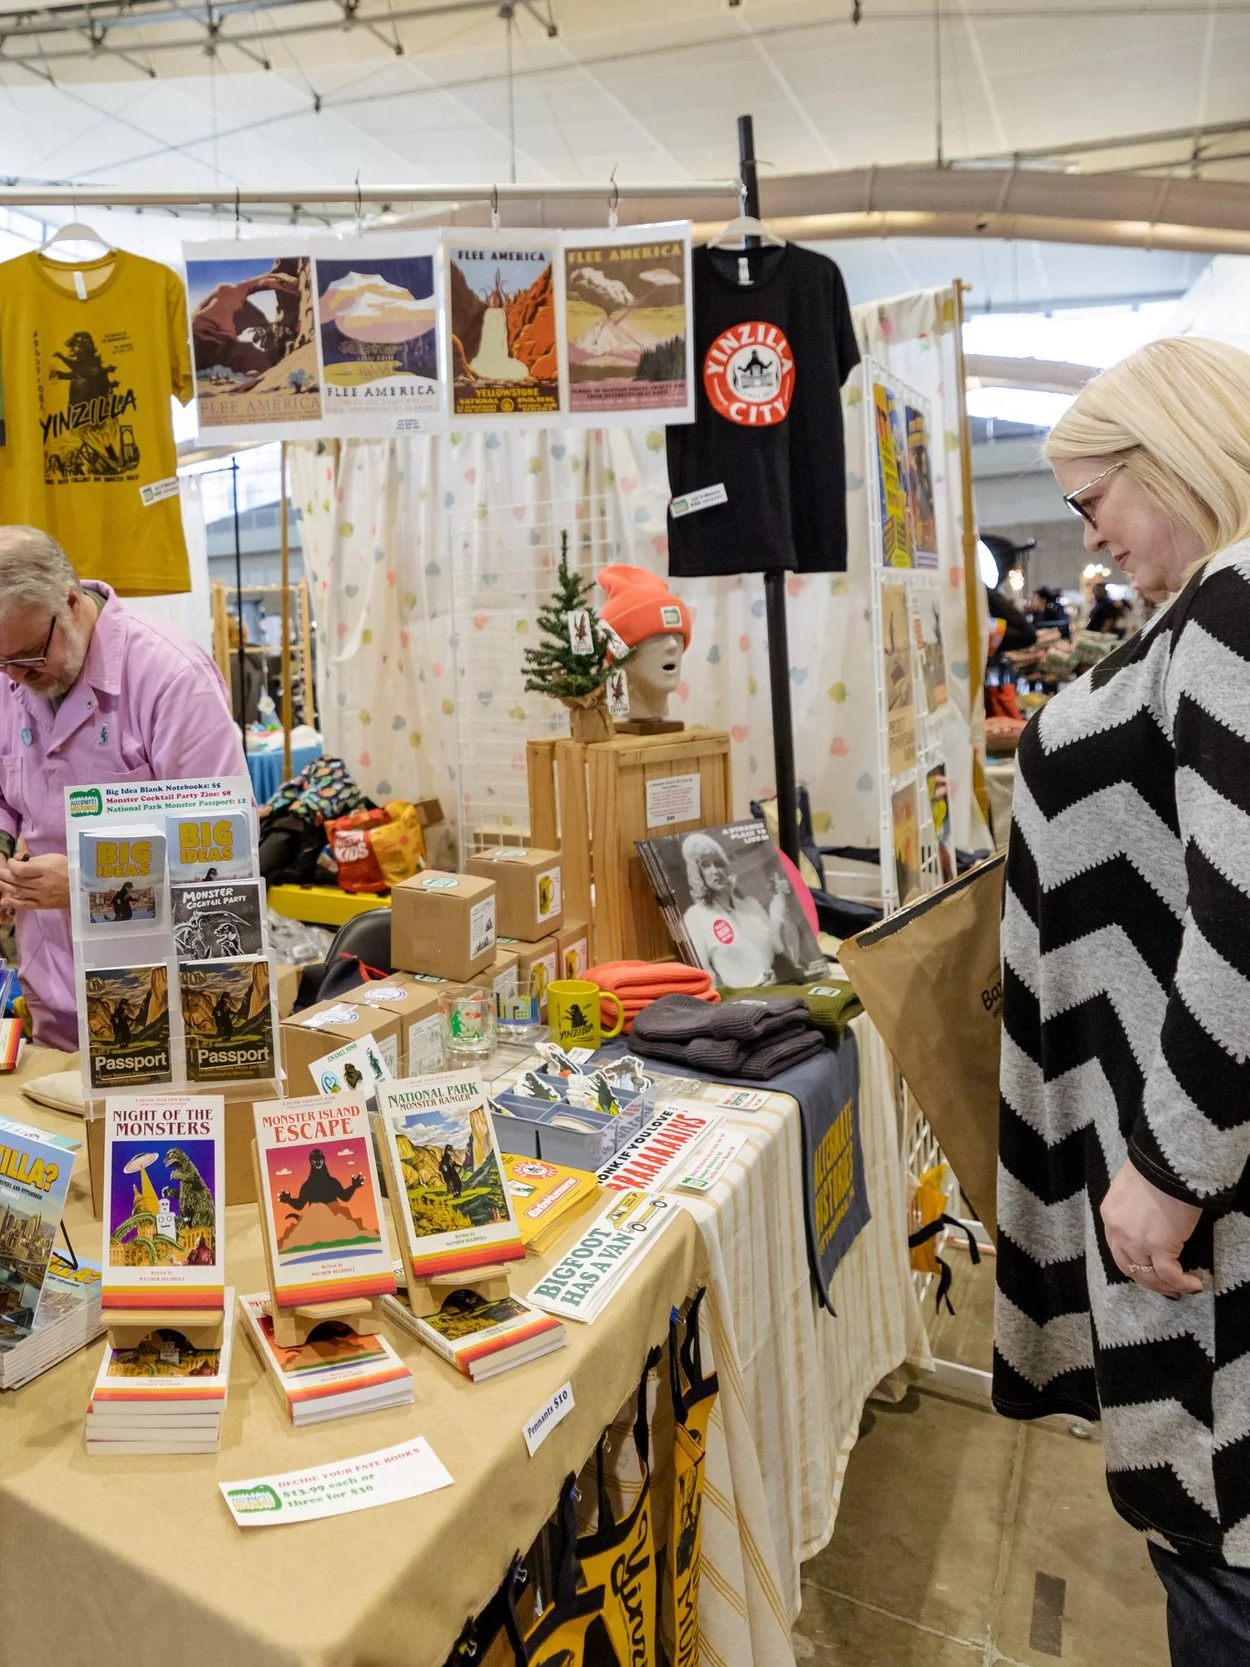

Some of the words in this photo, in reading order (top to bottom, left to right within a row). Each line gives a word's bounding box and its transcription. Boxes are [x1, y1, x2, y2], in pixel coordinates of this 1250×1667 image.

[458, 250, 485, 260] FLEE
[491, 251, 545, 262] AMERICA
[568, 251, 602, 264] FLEE
[609, 245, 681, 262] AMERICA
[706, 323, 793, 375] YINZILLA
[327, 386, 357, 398] FLEE
[364, 384, 435, 397] AMERICA
[475, 388, 539, 397] YELLOWSTONE
[200, 401, 239, 415] FLEE
[251, 396, 320, 410] AMERICA
[729, 400, 787, 424] CITY
[39, 389, 137, 445] YINZILLA
[106, 788, 119, 796] Big
[140, 785, 163, 793] Blank
[166, 783, 210, 791] Notebooks:
[106, 796, 139, 804] Monster
[141, 794, 174, 802] Cocktail
[176, 792, 198, 801] Party
[107, 805, 141, 813] National
[143, 803, 162, 811] Park
[198, 799, 235, 808] Passport:
[178, 820, 234, 849] BIG
[730, 830, 756, 840] PLACE
[96, 840, 153, 865] BIG
[180, 847, 234, 865] IDEAS
[96, 864, 150, 879] IDEAS
[183, 887, 234, 904] MONSTER
[186, 899, 221, 910] COCKTAIL
[223, 894, 247, 906] PARTY
[95, 1052, 167, 1071] Passport
[198, 1047, 270, 1066] Passport
[388, 1087, 444, 1108] NATIONAL
[447, 1082, 479, 1096] PARK
[400, 1098, 437, 1111] MONSTER
[439, 1094, 471, 1105] RANGER
[112, 1110, 158, 1122] NIGHT
[162, 1109, 181, 1121] OF
[186, 1109, 214, 1121] THE
[262, 1111, 315, 1127] MONSTER
[318, 1105, 360, 1119] ISLAND
[116, 1122, 211, 1137] MONSTERS
[274, 1118, 354, 1143] ESCAPE
[618, 1150, 632, 1161] IF
[627, 1131, 651, 1151] YOU
[12, 1184, 20, 1192] AND
[21, 1187, 43, 1200] PITTSBURGH
[534, 1227, 612, 1300] BIGFOOT
[561, 1273, 599, 1306] HAS
[597, 1256, 612, 1273] A
[607, 1233, 635, 1262] VAN
[527, 1405, 553, 1439] Pennants
[553, 1390, 568, 1409] $10
[278, 1475, 319, 1488] DECIDE
[322, 1468, 353, 1479] YOUR
[355, 1460, 381, 1472] FATE
[384, 1447, 420, 1464] BOOKS
[328, 1477, 358, 1489] each
[361, 1474, 375, 1482] or
[288, 1497, 323, 1508] three
[326, 1492, 346, 1501] for
[351, 1485, 373, 1496] $30
